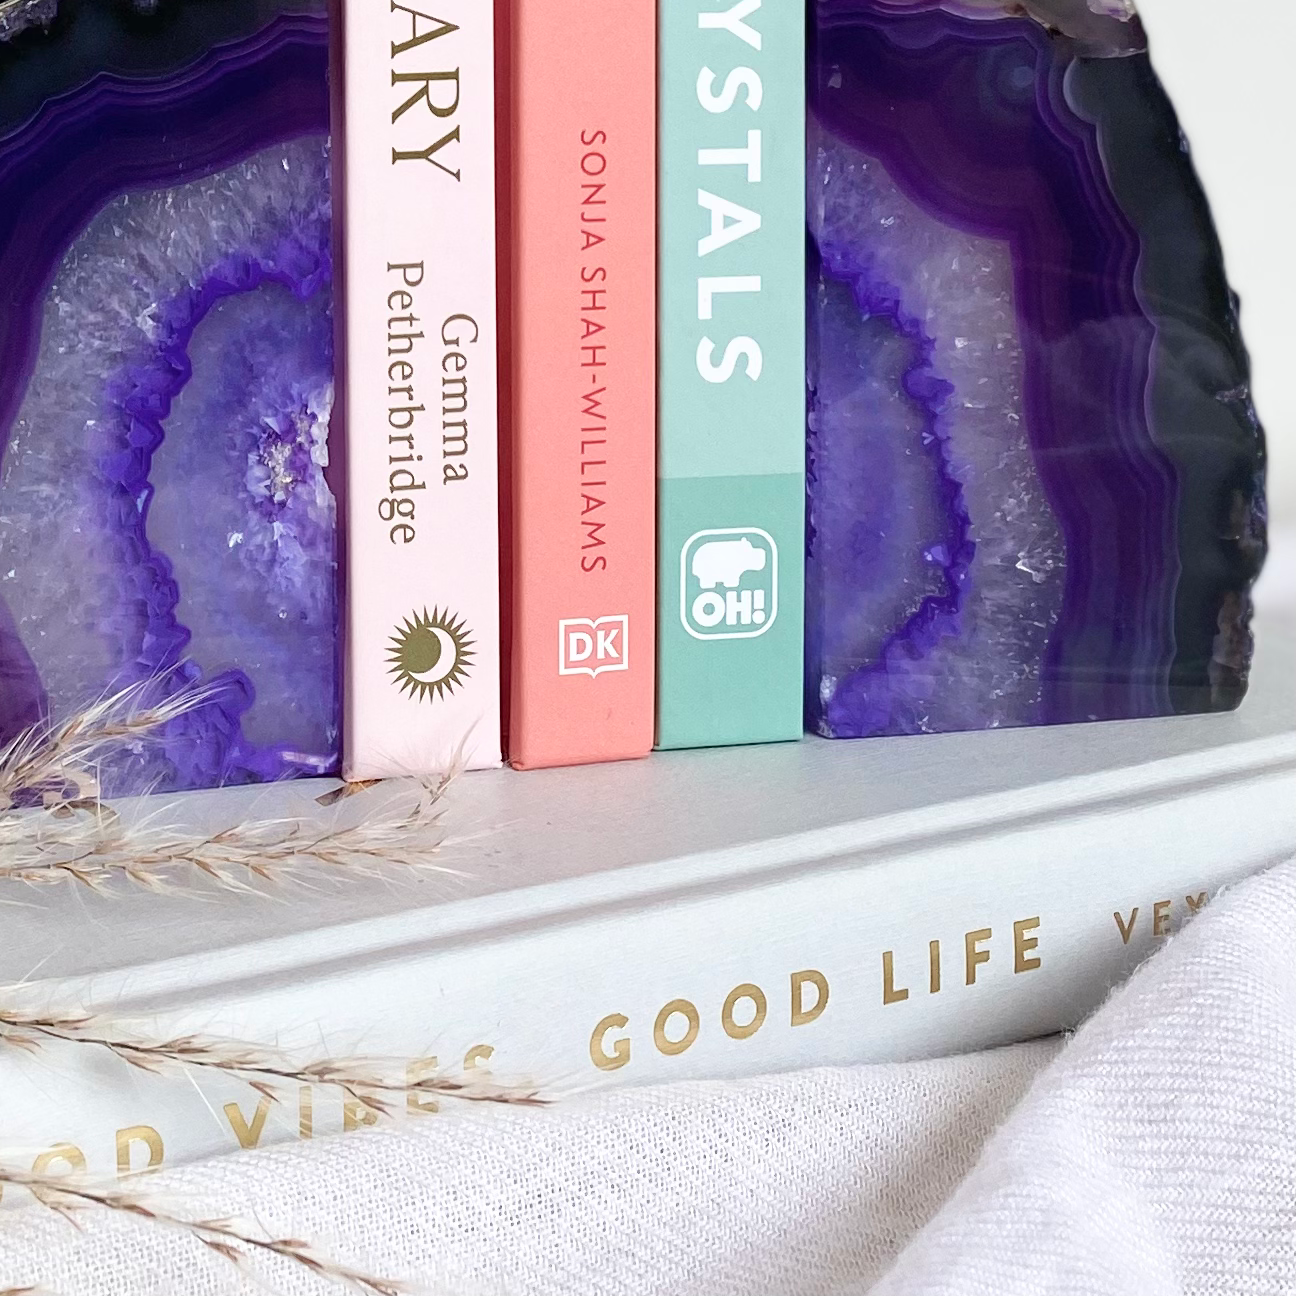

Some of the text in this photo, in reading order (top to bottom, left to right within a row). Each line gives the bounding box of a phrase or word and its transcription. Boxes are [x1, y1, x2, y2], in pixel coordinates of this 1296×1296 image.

[378, 260, 426, 545] Petherbridge
[441, 313, 479, 485] Gemma
[580, 129, 607, 573] SONJA SHAH-WILLIAMS
[569, 628, 620, 662] DK
[692, 589, 766, 627] OH!
[589, 969, 830, 1072] GOOD
[882, 916, 1041, 1005] LIFE
